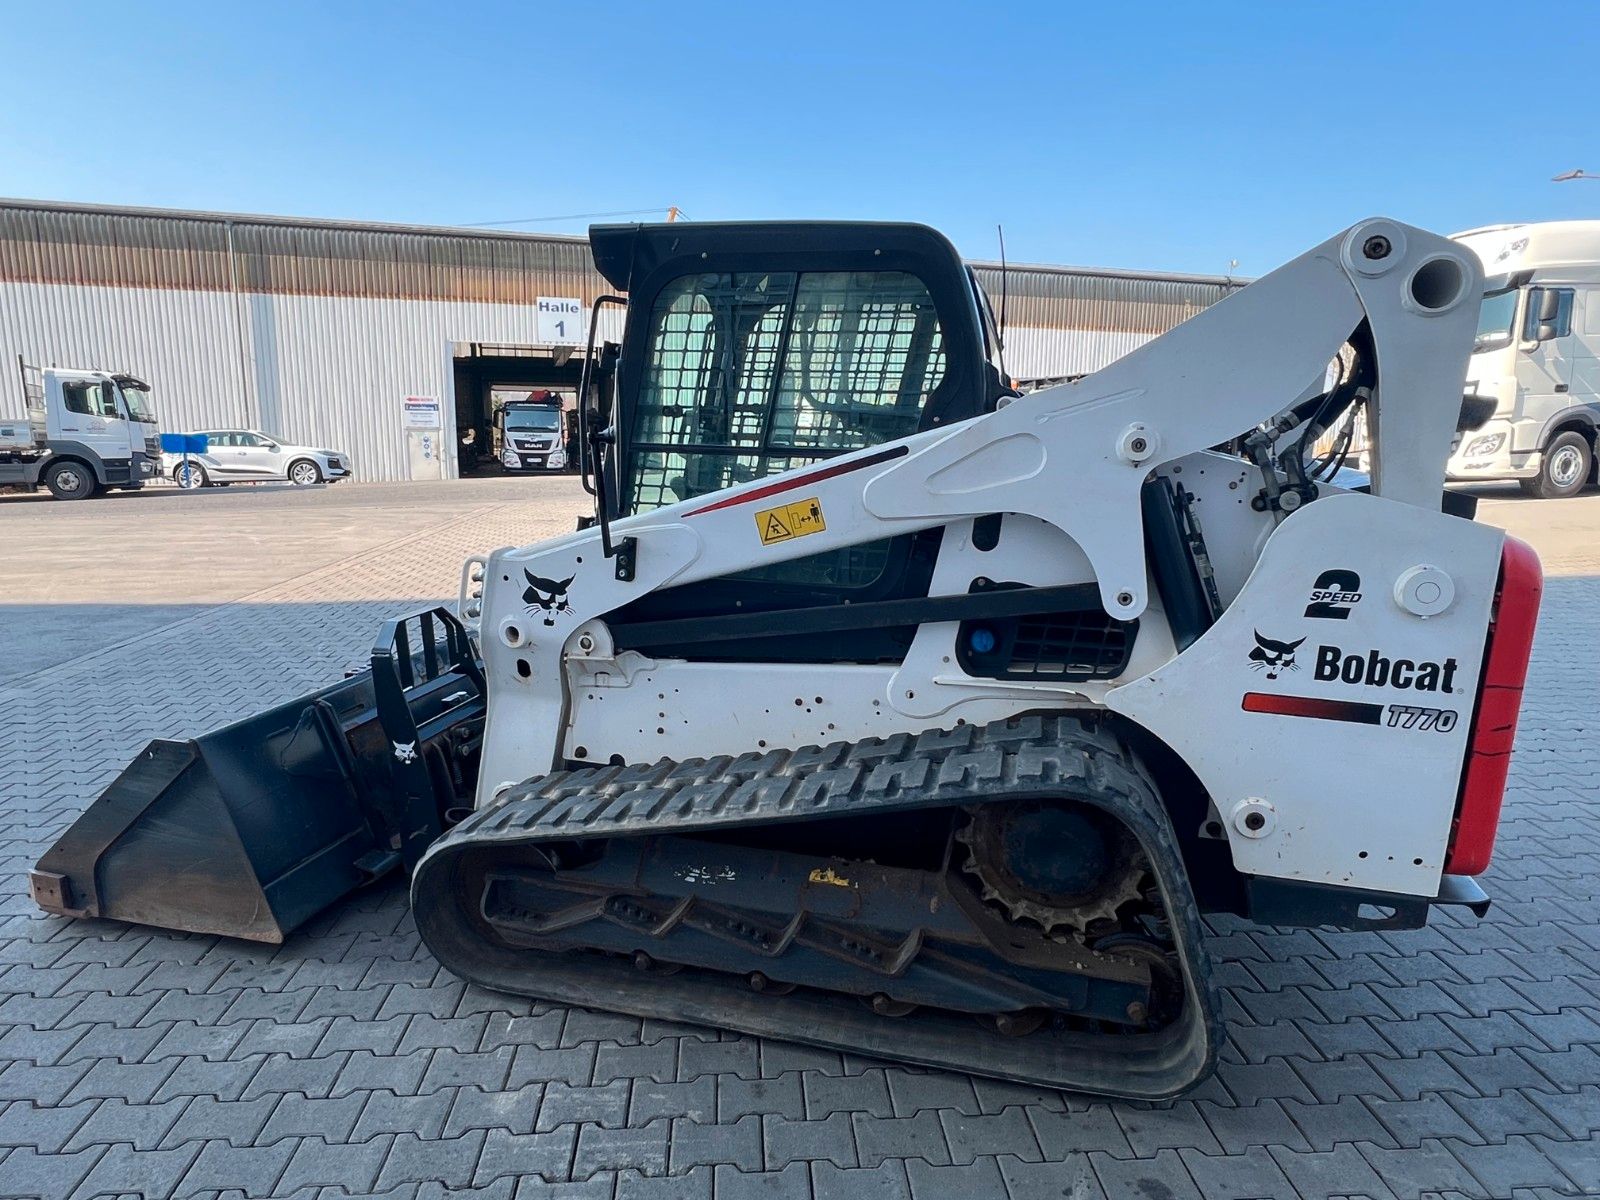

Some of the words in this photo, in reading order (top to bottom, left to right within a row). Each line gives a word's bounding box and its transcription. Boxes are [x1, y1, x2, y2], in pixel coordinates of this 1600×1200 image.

[539, 301, 580, 314] Halle
[555, 320, 565, 338] 1
[1303, 569, 1361, 620] 2
[1310, 591, 1362, 603] SPEED
[1314, 645, 1458, 694] Bobcat
[1387, 704, 1458, 733] T770
